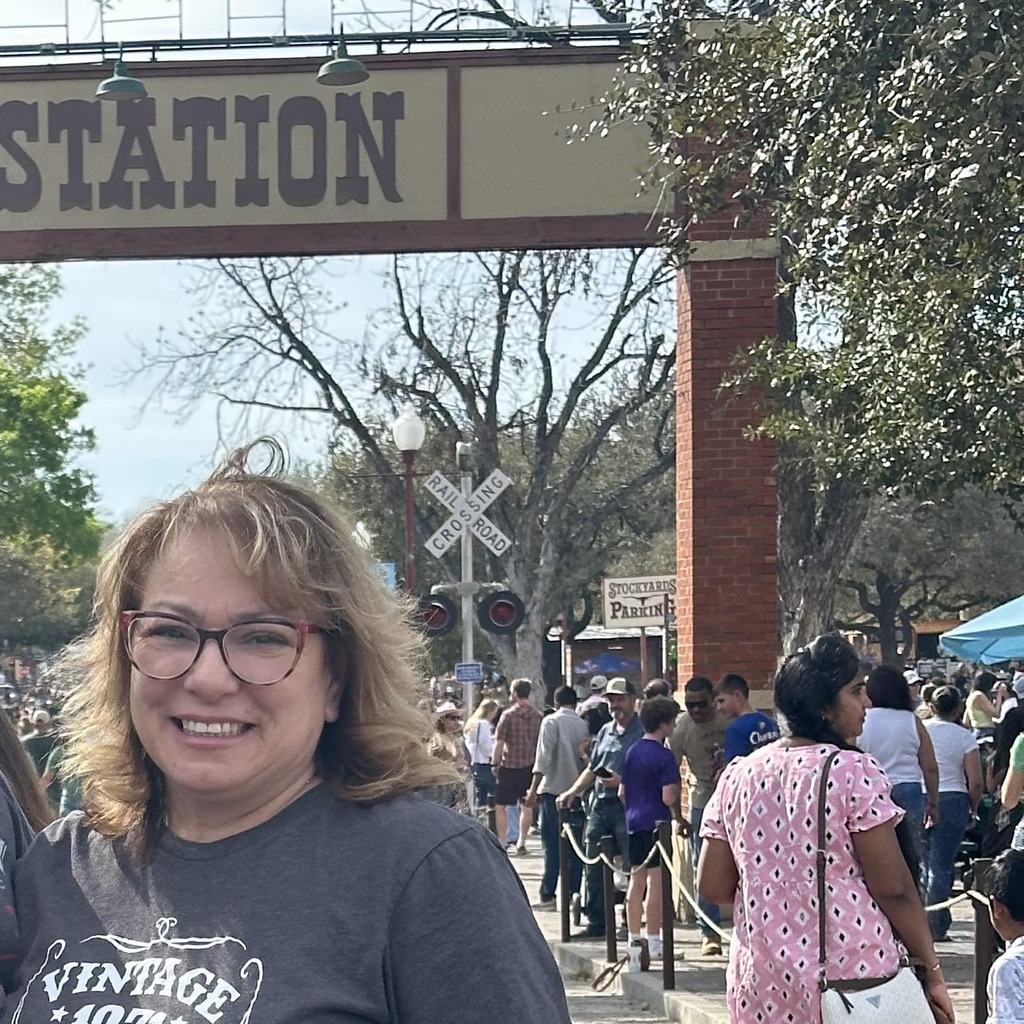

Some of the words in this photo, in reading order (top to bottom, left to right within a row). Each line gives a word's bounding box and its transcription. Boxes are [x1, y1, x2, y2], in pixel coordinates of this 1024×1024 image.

[428, 475, 459, 510] RAIL
[472, 517, 506, 552] ROAD
[432, 476, 504, 550] CROSSING
[42, 957, 240, 1024] VINTAGE
